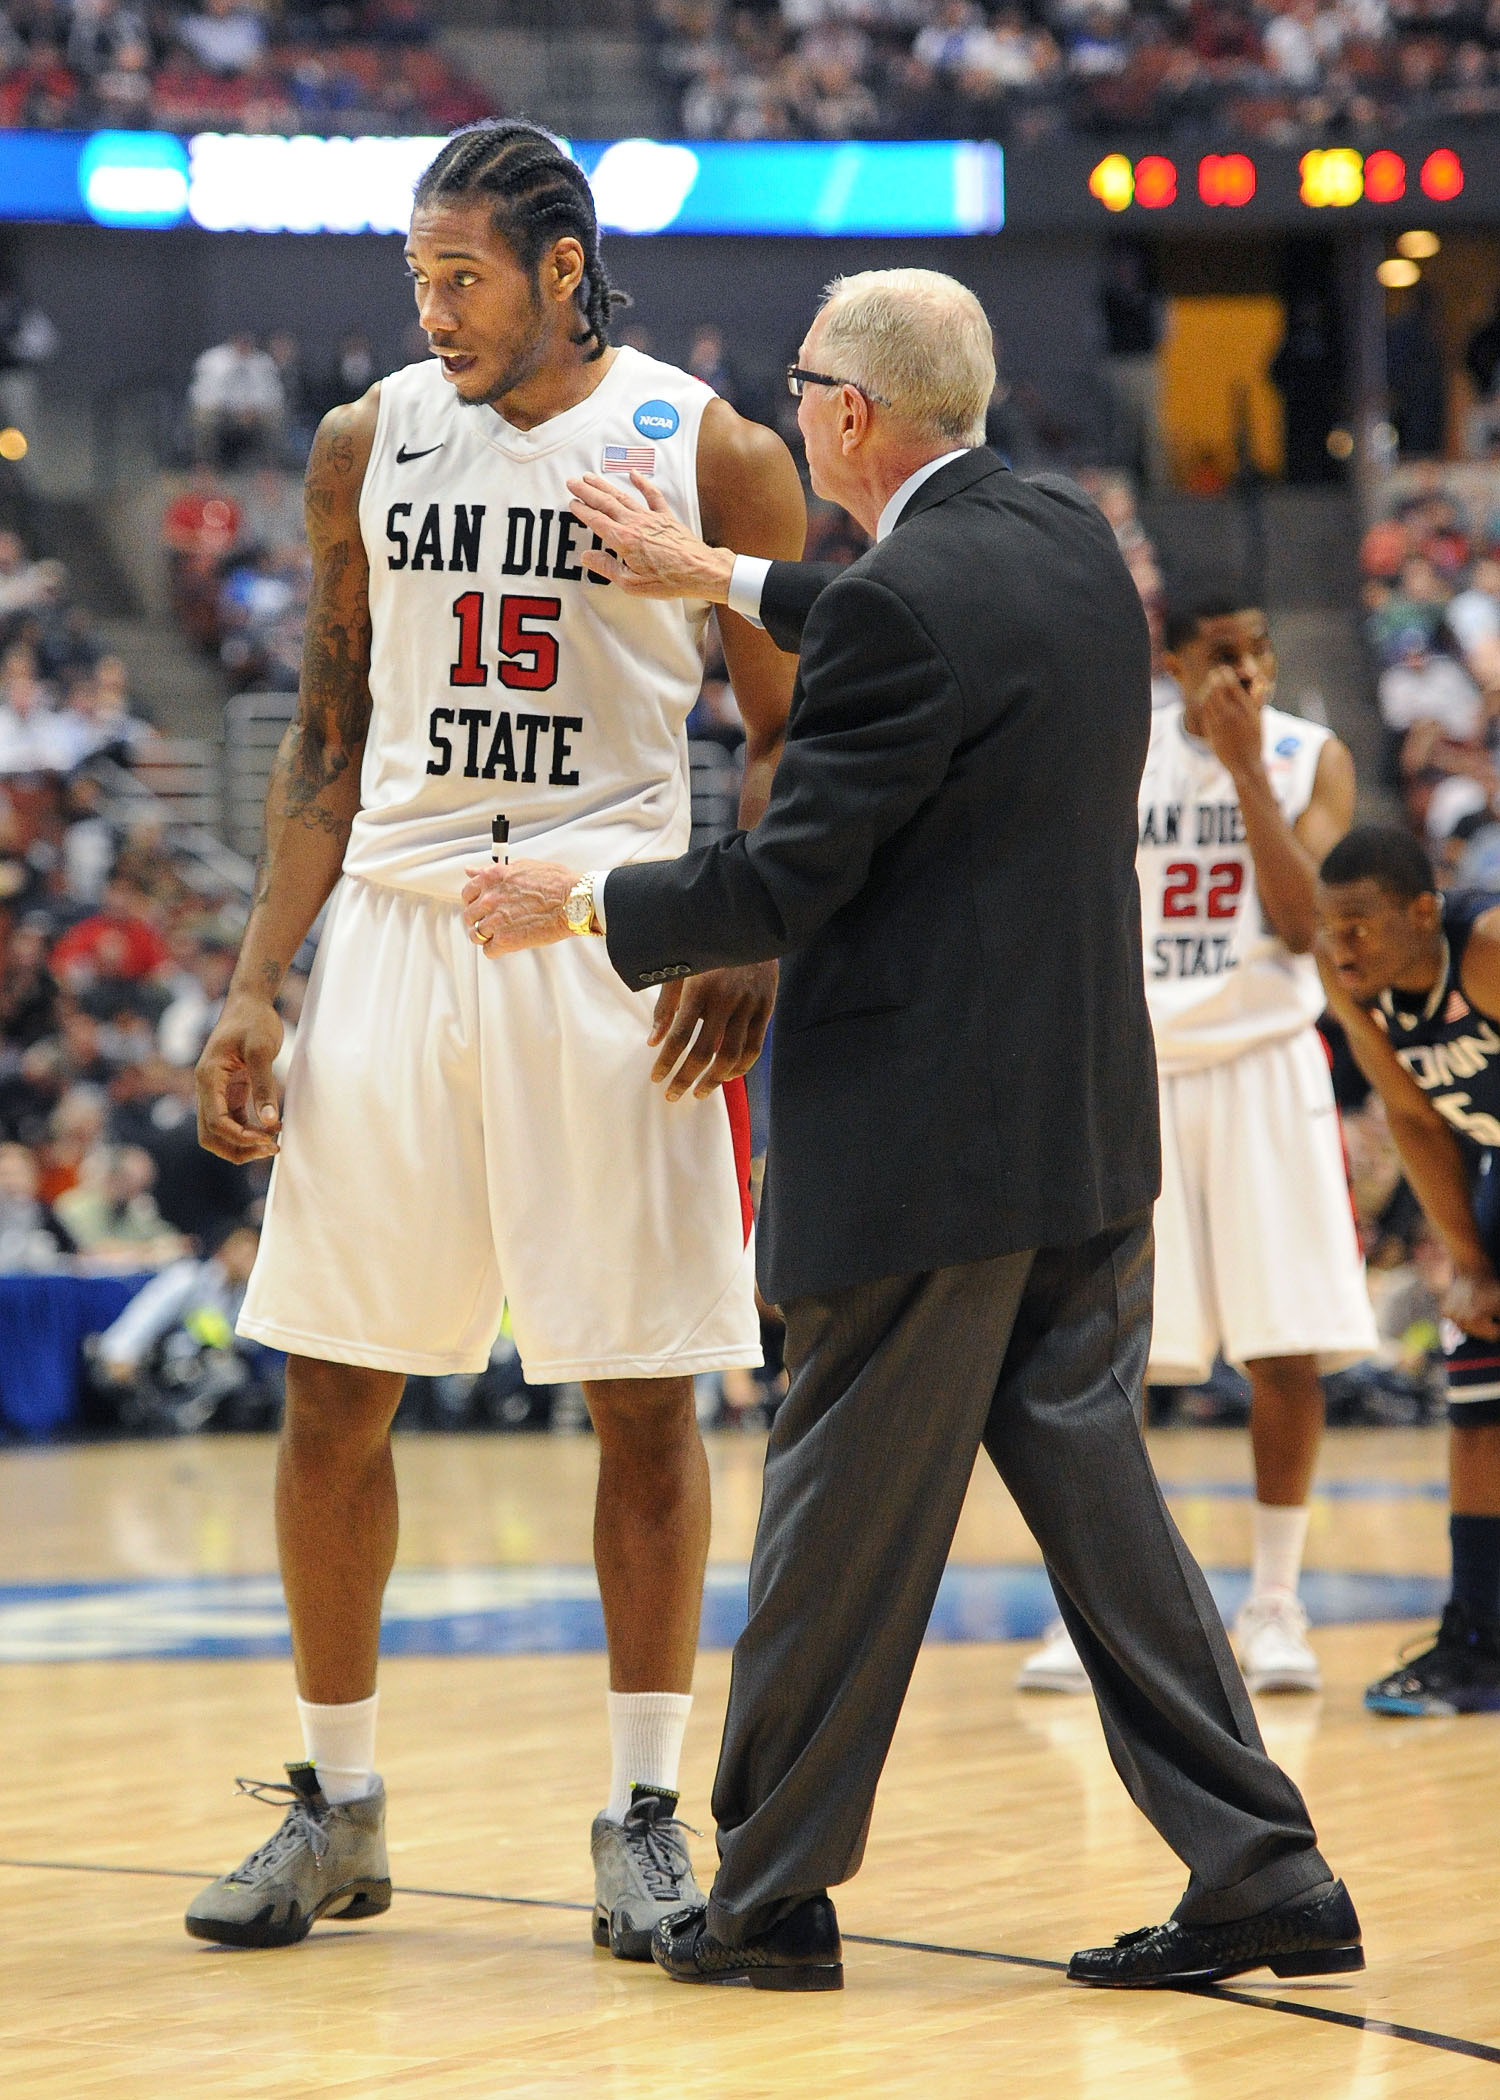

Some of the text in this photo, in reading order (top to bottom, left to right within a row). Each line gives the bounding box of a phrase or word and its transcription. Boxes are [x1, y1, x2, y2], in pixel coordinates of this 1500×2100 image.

[639, 415, 674, 430] NCAA
[386, 502, 618, 586] SAN DIE
[450, 591, 562, 692] 15
[426, 707, 583, 786] STATE
[1139, 803, 1248, 845] AN DIE
[1163, 862, 1244, 919] 22
[1396, 1019, 1500, 1091] ONN
[1431, 1090, 1500, 1148] 5
